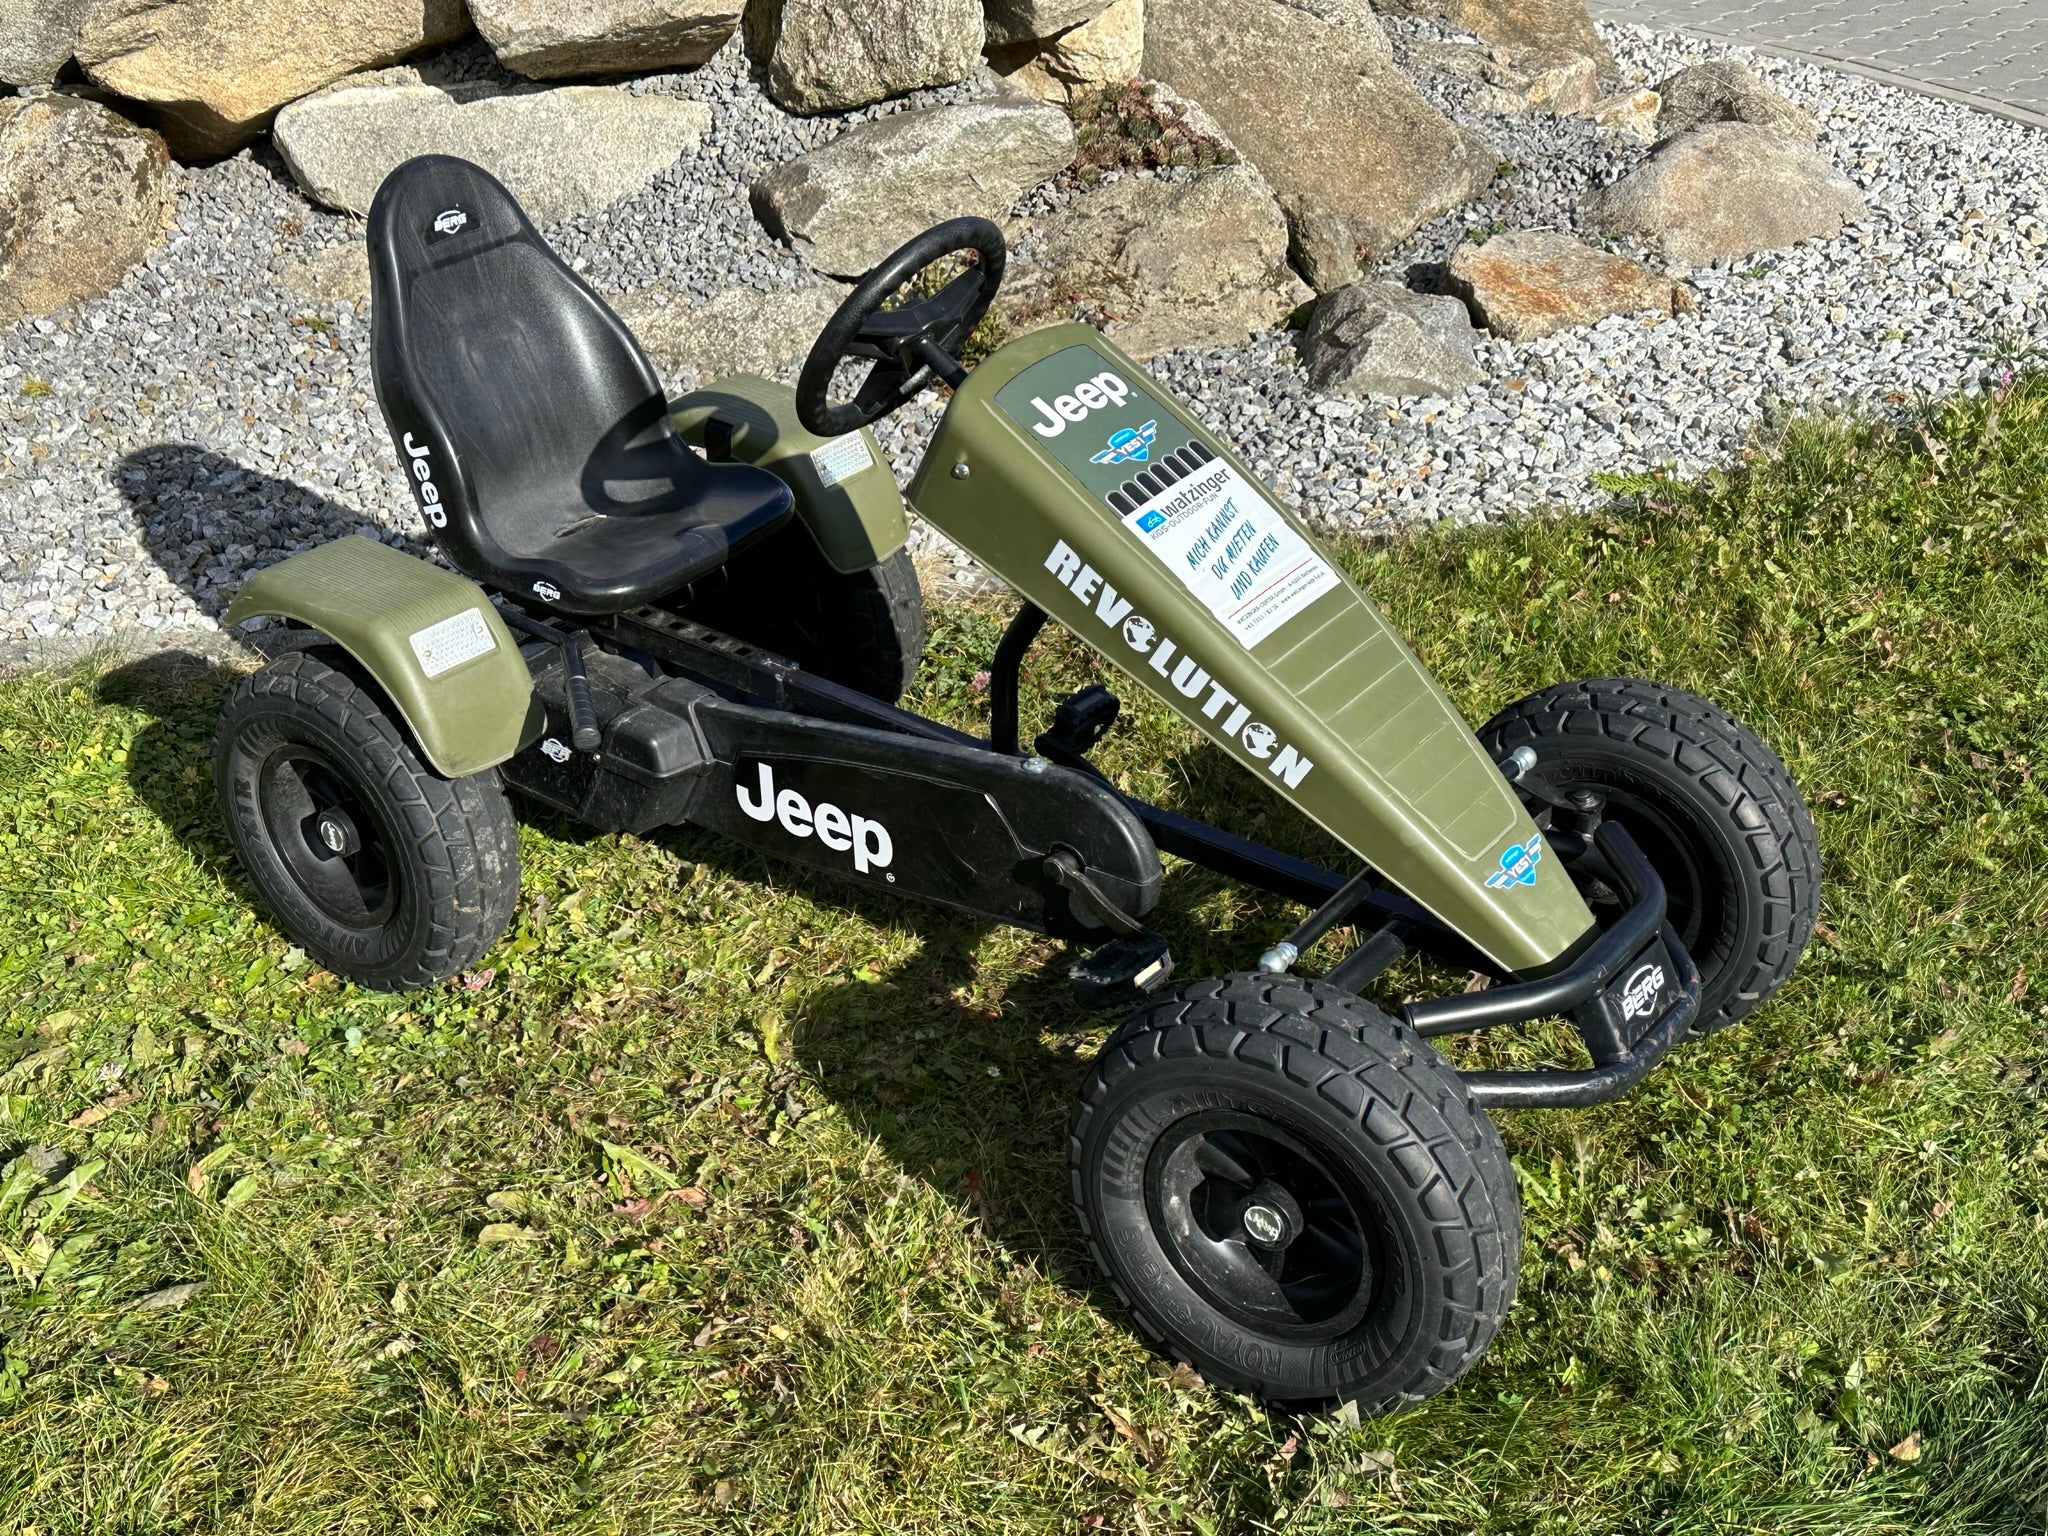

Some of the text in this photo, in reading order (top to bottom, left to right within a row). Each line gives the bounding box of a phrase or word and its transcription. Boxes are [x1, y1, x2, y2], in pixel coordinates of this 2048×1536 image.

[434, 211, 467, 233] BERG
[1030, 371, 1128, 438] Jeep
[403, 432, 447, 529] Jeep
[1186, 497, 1239, 570] MICH KANNST
[1211, 519, 1257, 580] DU MIETEN
[1230, 532, 1280, 600] UND KAUFEN
[532, 581, 561, 601] BERG
[736, 762, 893, 874] Jeep
[1622, 965, 1665, 1021] BERG
